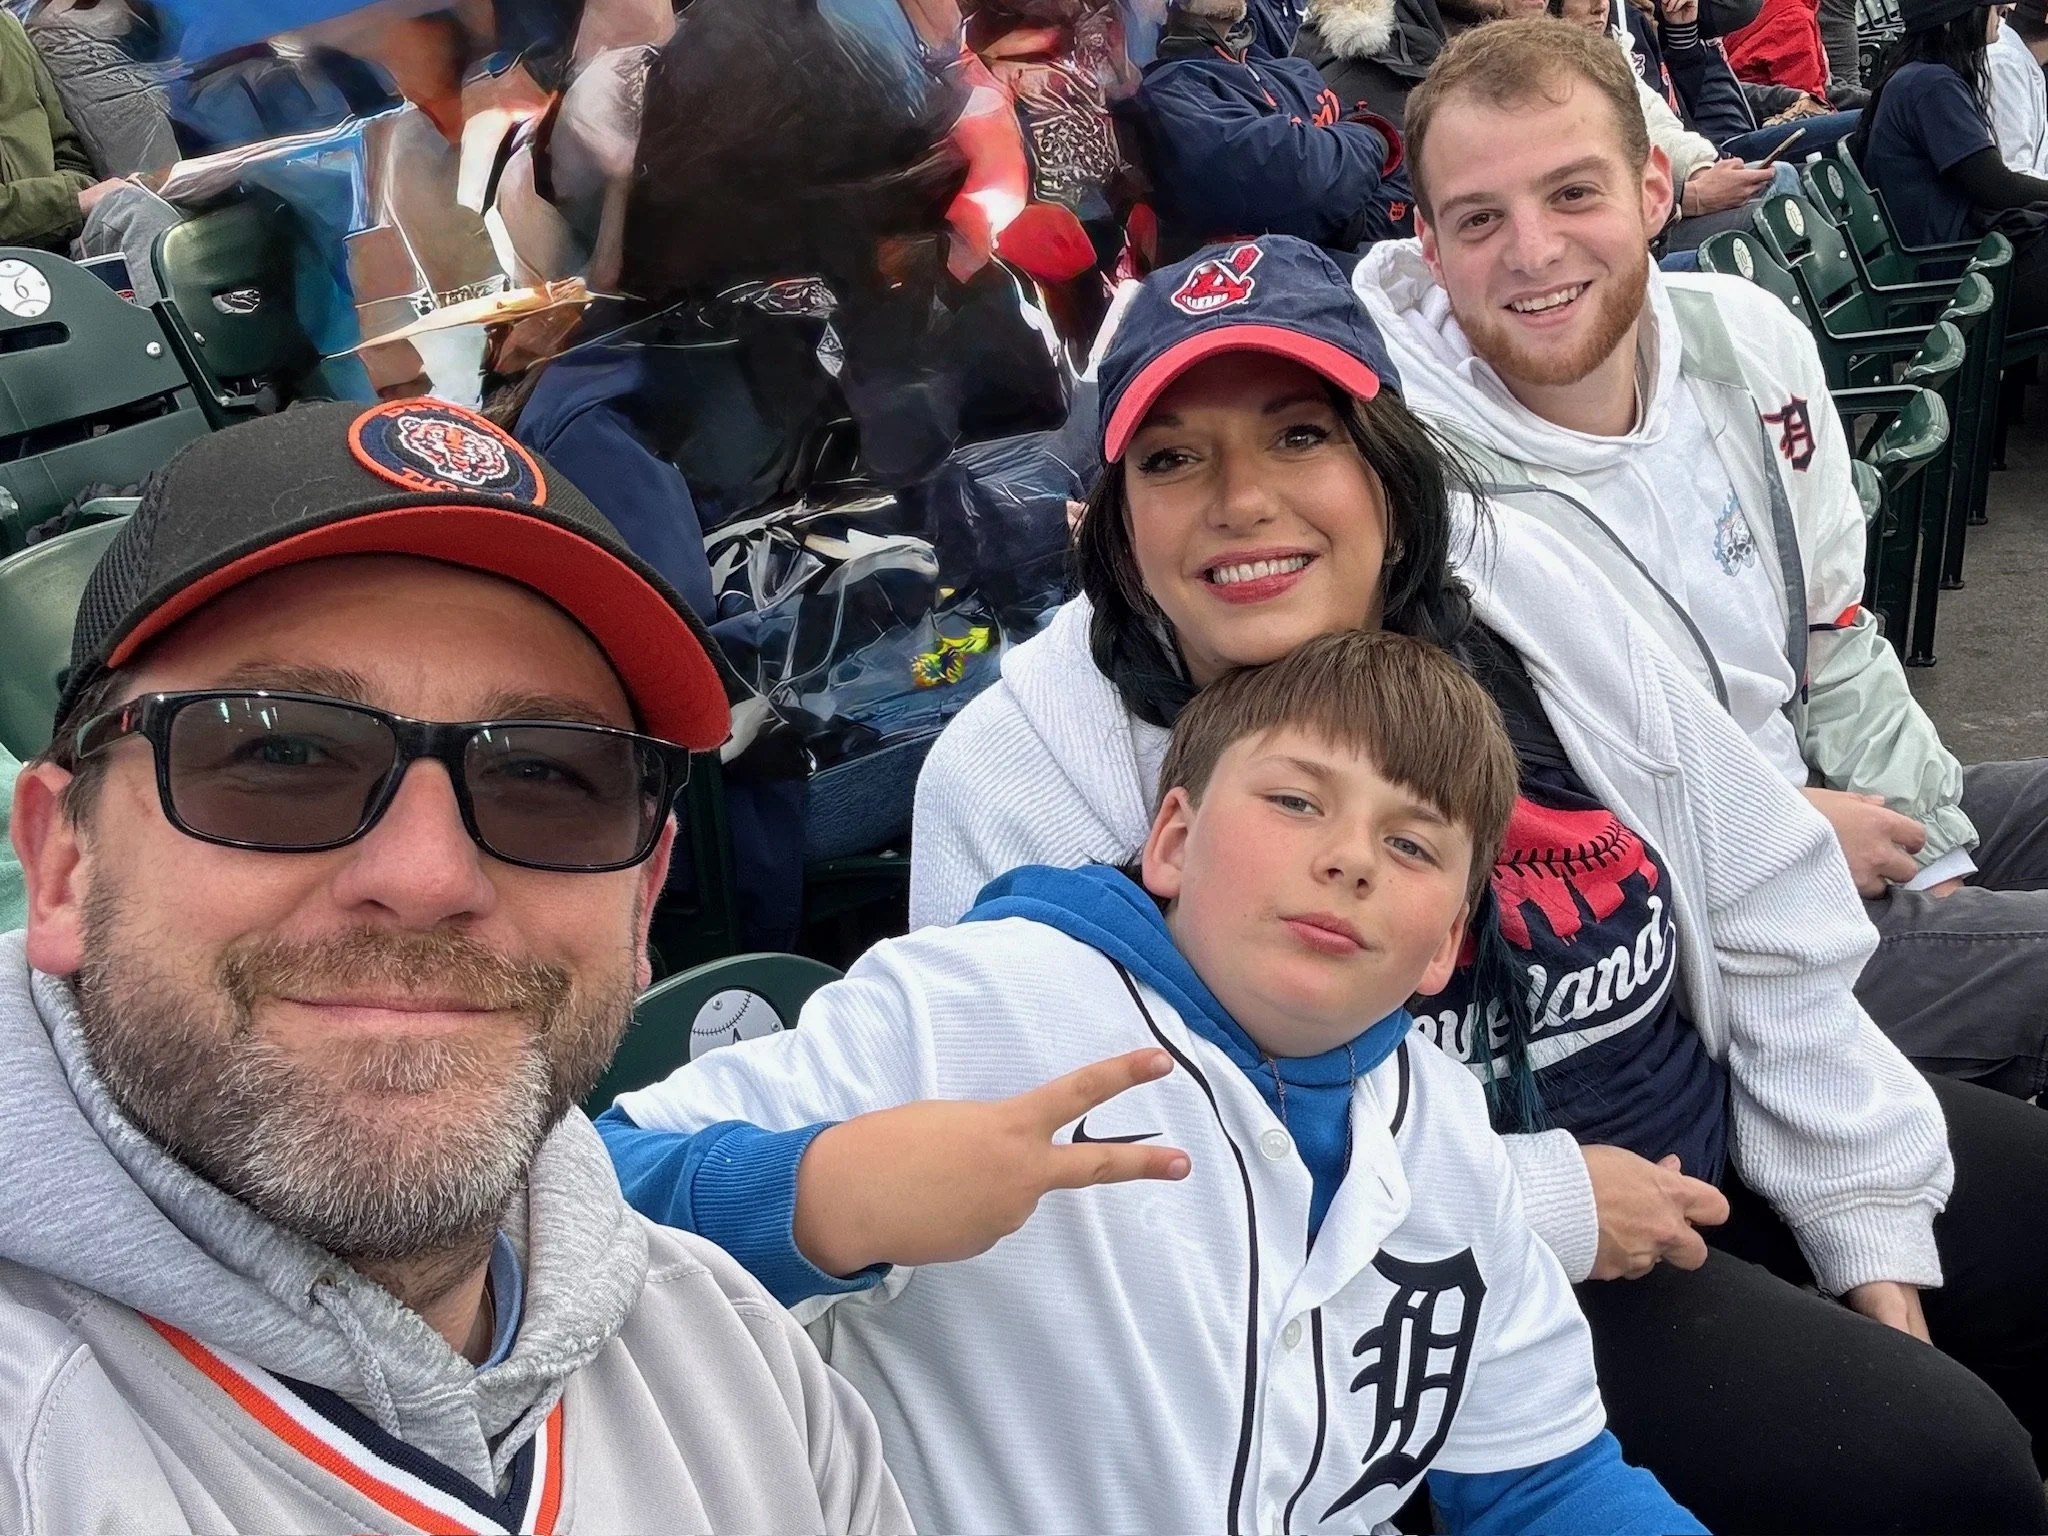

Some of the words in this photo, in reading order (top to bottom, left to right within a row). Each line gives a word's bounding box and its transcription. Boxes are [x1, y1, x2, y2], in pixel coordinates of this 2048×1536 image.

[13, 277, 30, 300] 6
[1762, 392, 1817, 473] D
[1318, 1245, 1488, 1525] D
